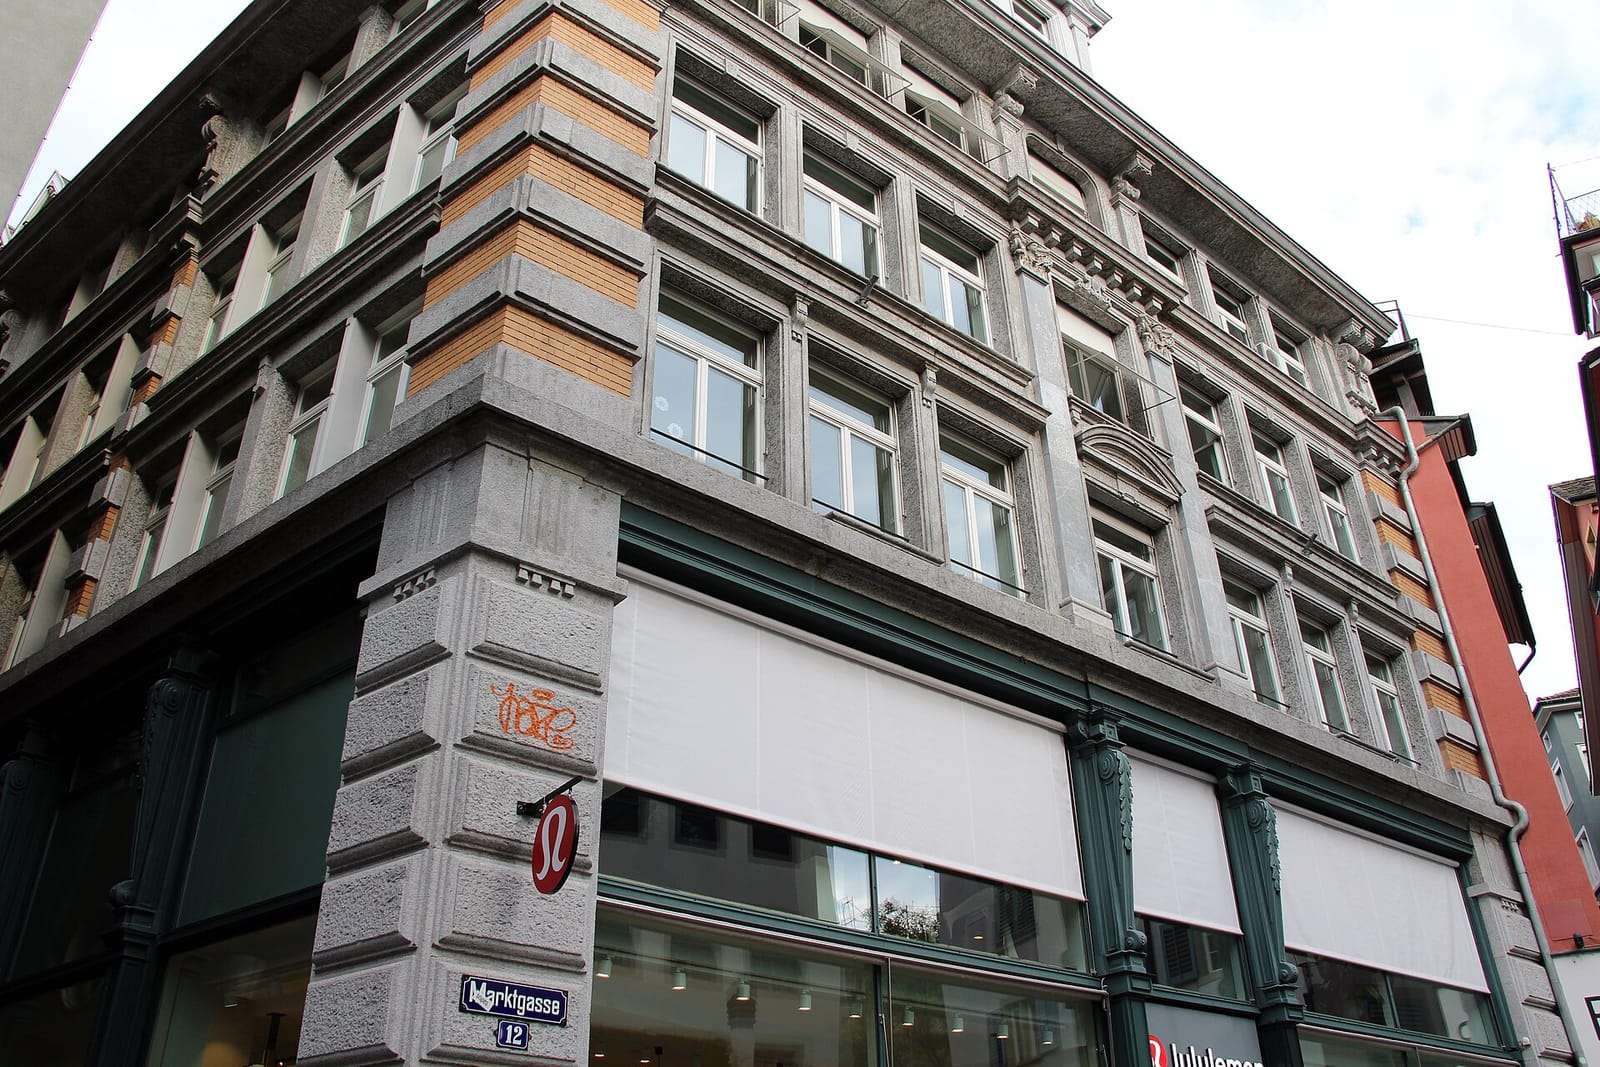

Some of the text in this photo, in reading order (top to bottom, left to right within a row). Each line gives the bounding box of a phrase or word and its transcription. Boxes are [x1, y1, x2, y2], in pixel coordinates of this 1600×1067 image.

[469, 980, 560, 1015] Marktgasse
[505, 1024, 523, 1045] 12
[1171, 1042, 1264, 1067] lulule
